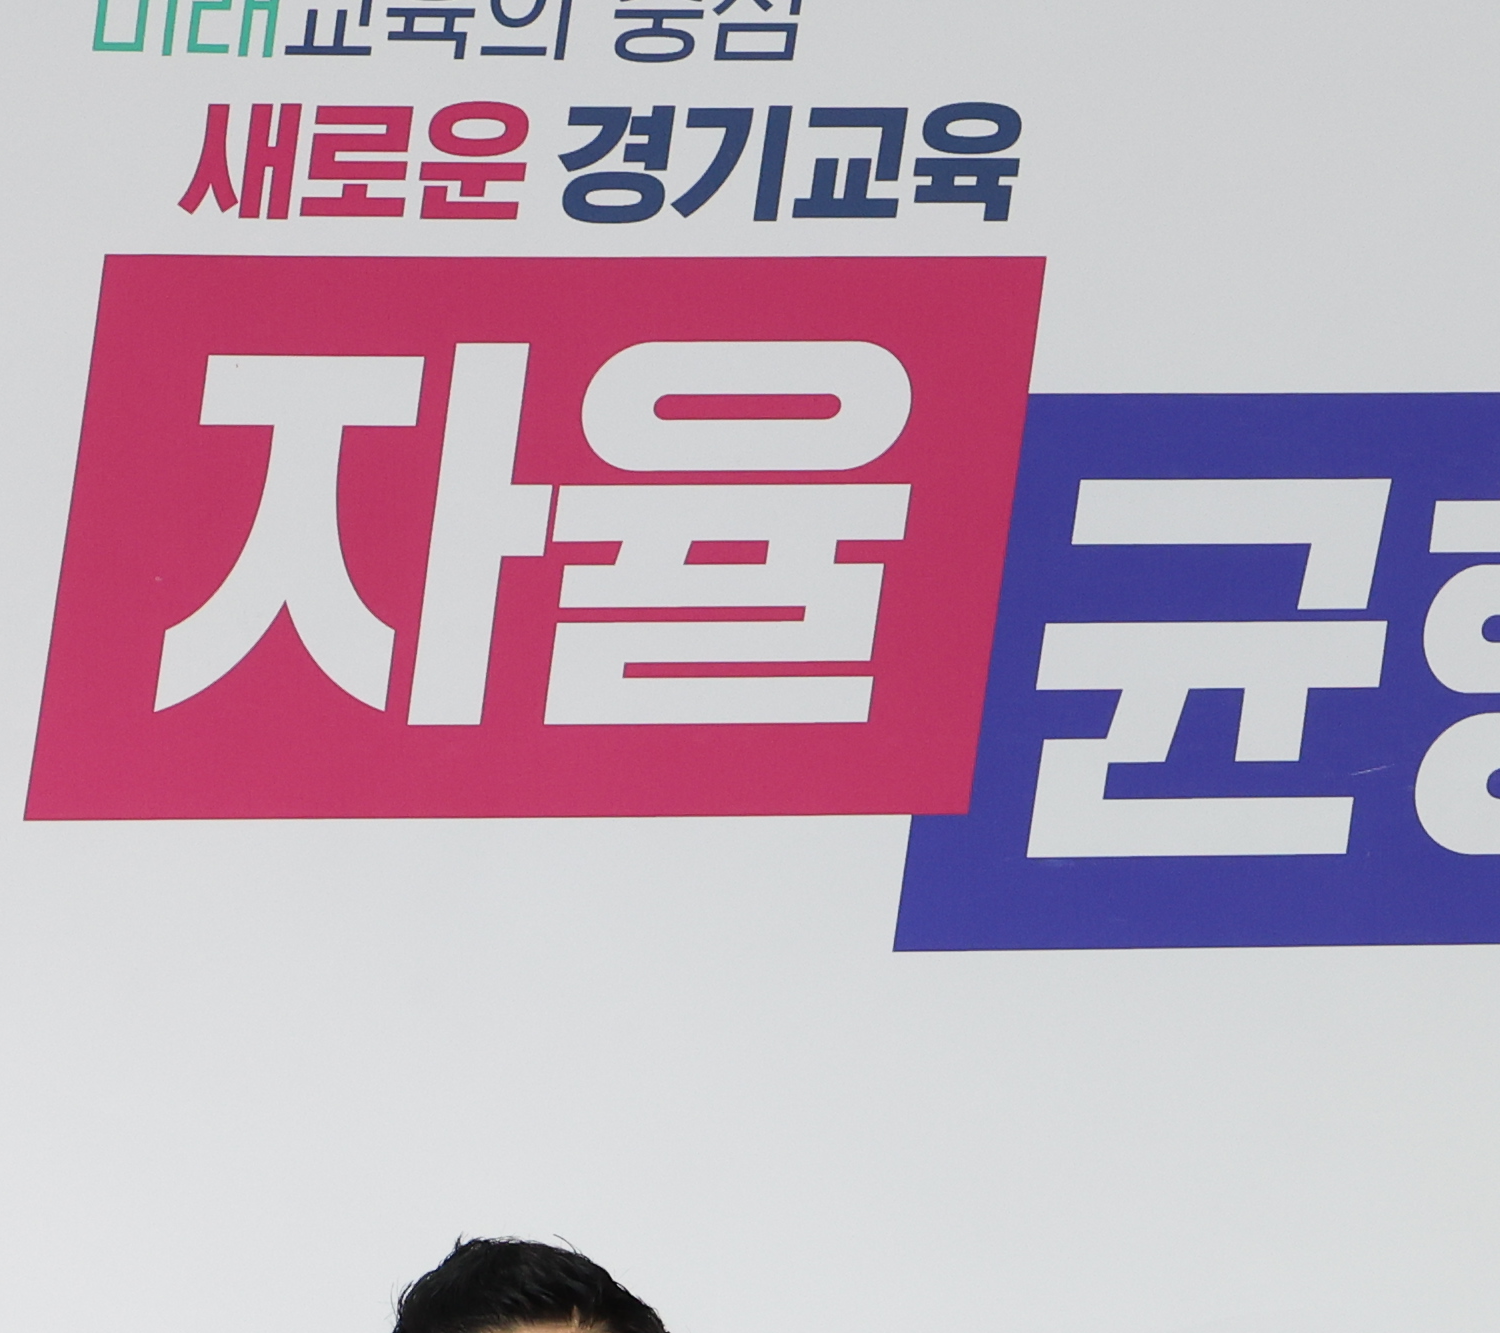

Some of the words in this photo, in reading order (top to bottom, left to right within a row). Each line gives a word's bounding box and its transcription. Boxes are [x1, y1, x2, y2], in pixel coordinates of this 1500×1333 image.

[177, 100, 530, 221] 새로운
[557, 101, 1023, 225] 경기교육
[153, 340, 912, 726] 자율
